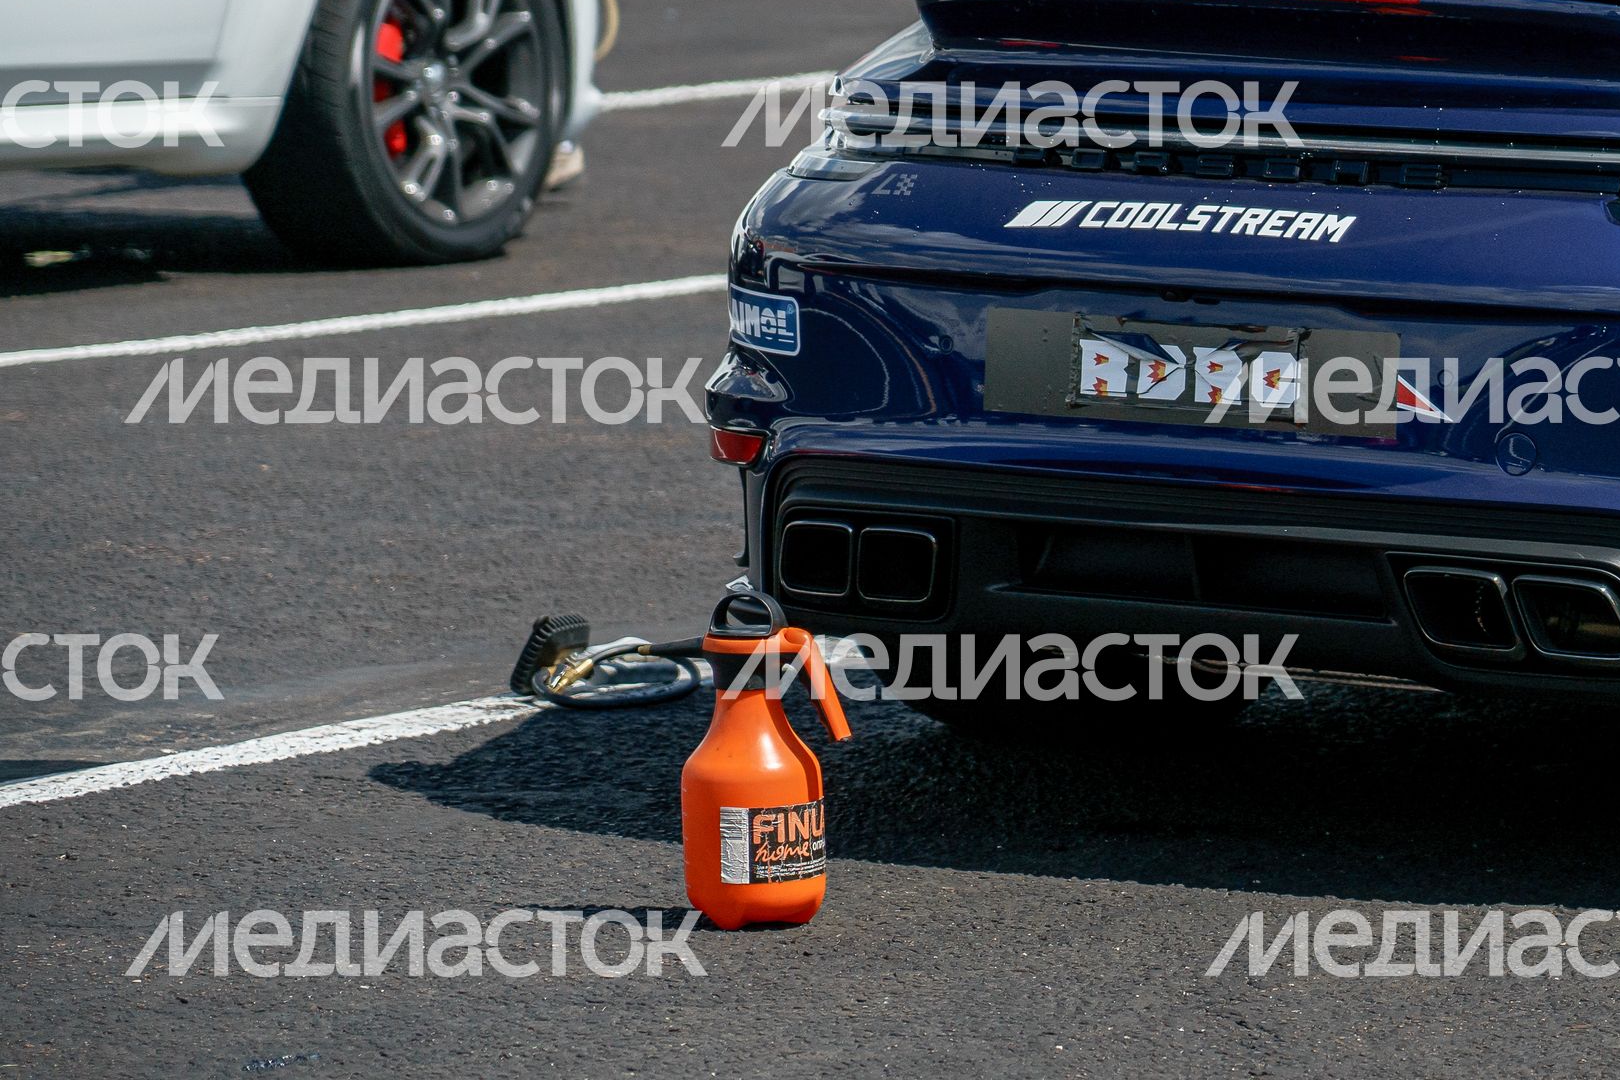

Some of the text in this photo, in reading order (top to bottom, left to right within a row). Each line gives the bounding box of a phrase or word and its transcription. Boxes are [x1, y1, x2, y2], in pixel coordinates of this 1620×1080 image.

[1079, 201, 1356, 243] COOLSTREAM
[731, 298, 795, 343] AIMOL
[754, 841, 810, 862] home
